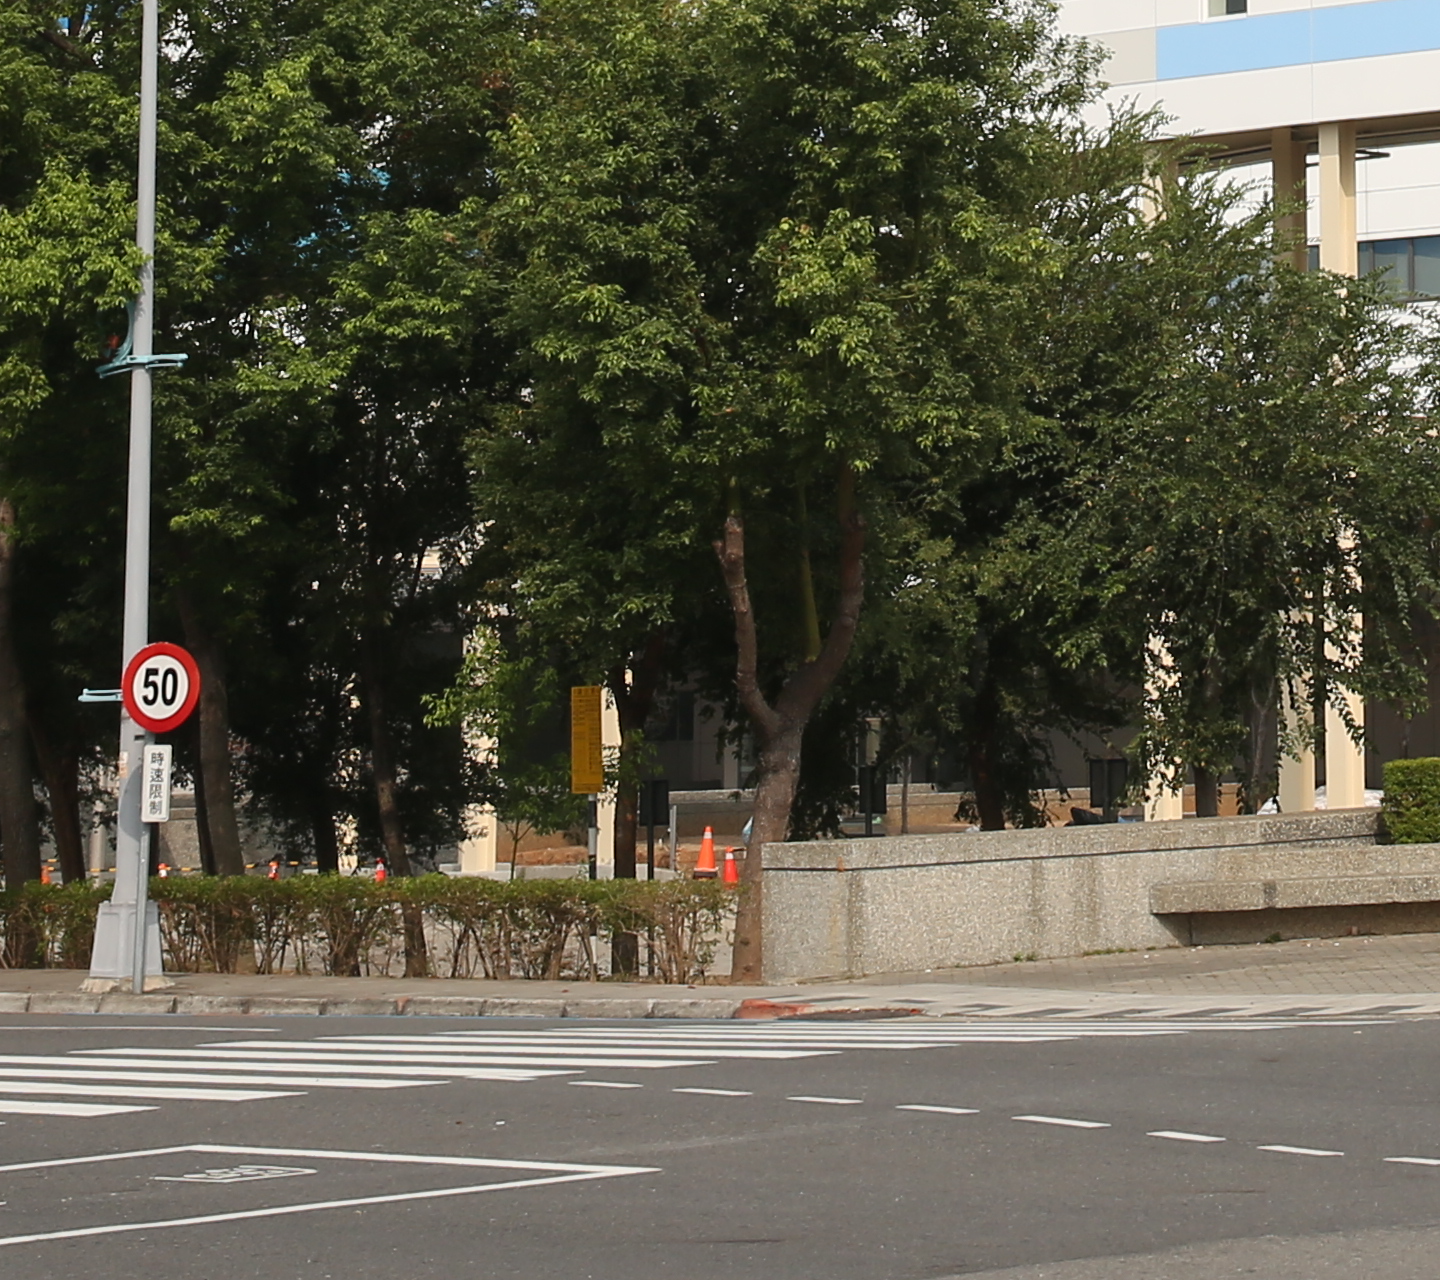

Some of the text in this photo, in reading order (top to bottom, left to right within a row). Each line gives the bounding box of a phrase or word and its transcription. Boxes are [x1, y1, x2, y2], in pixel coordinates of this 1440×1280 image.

[142, 667, 178, 707] 50
[149, 751, 165, 816] 時速限制
